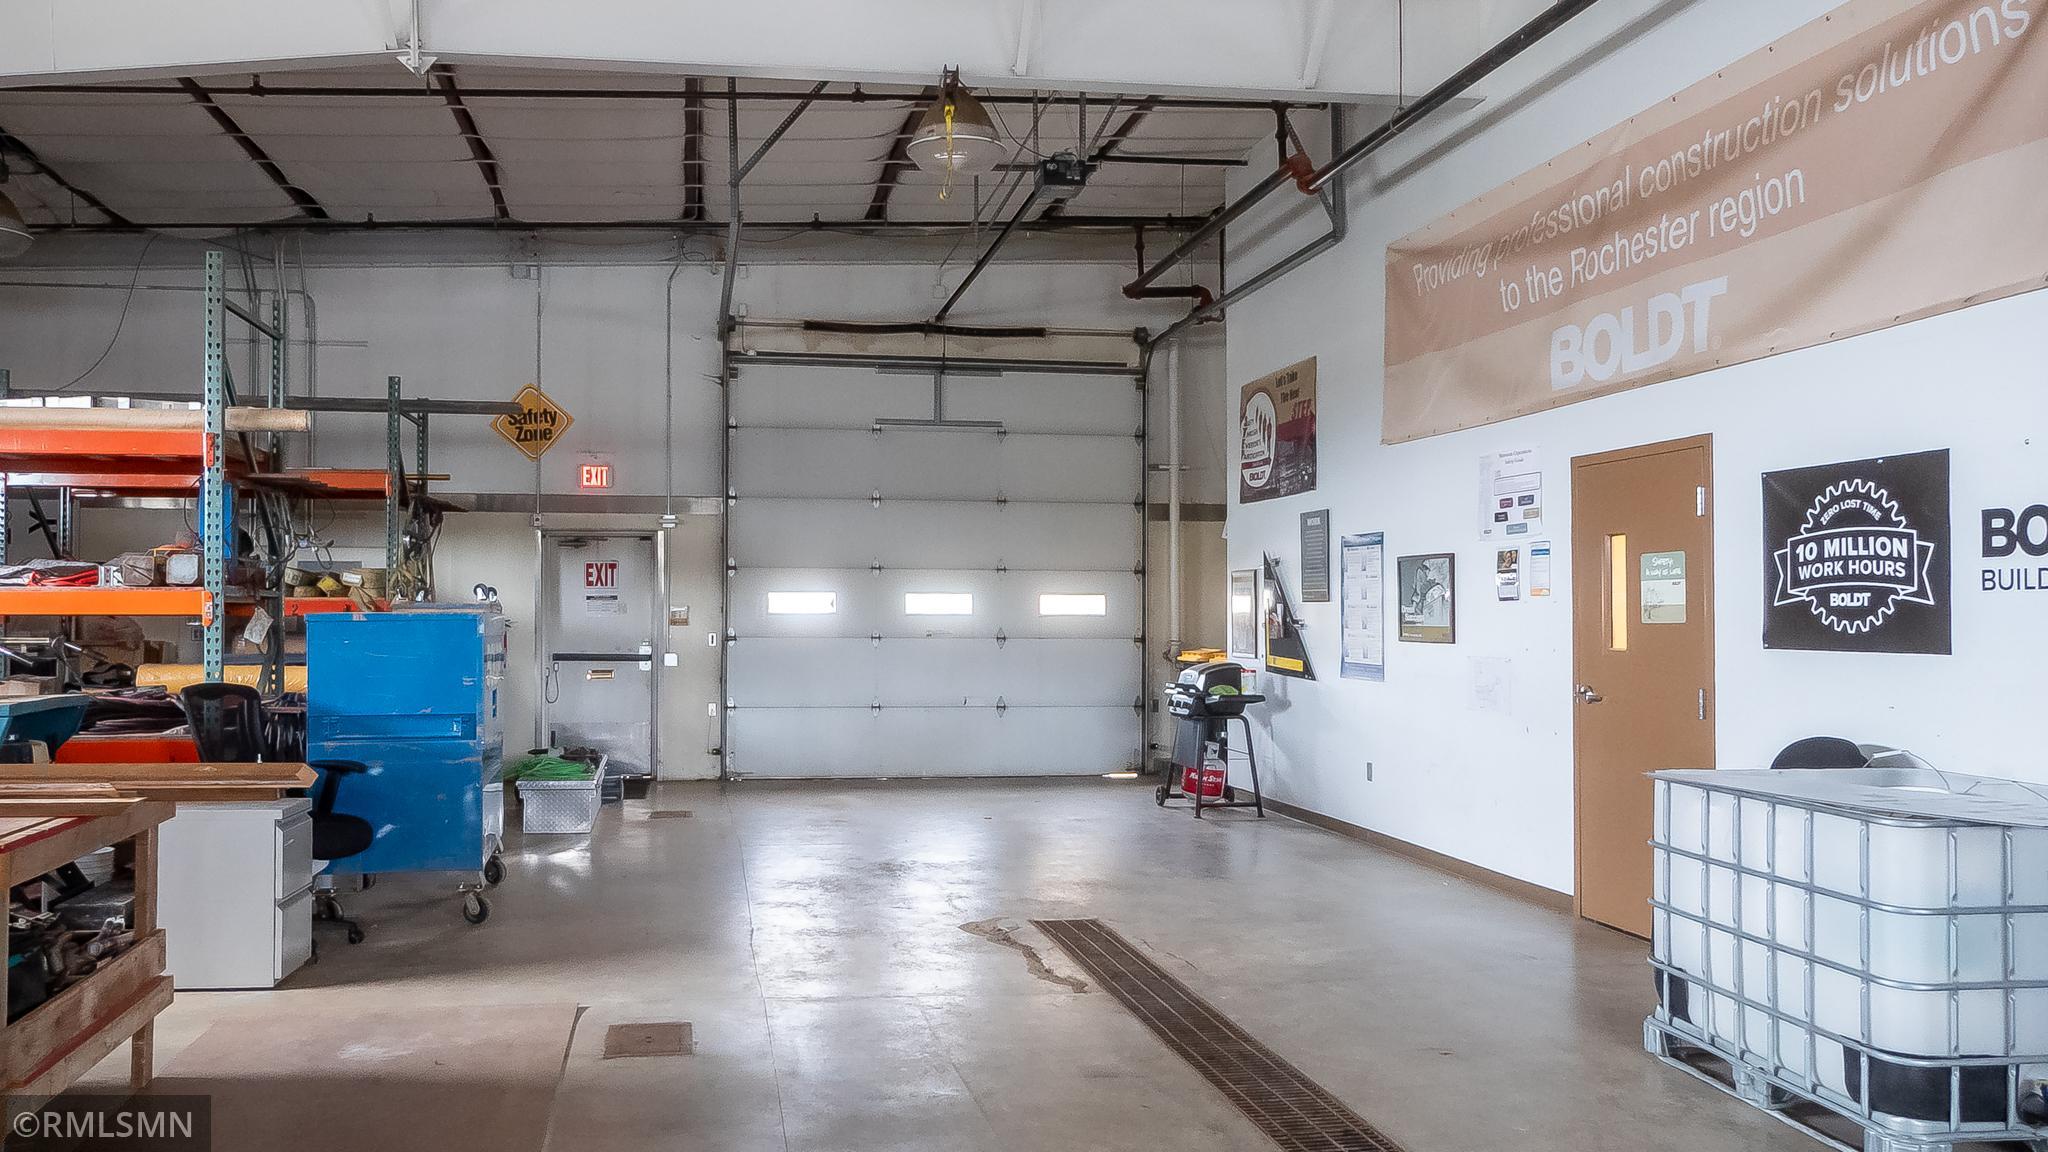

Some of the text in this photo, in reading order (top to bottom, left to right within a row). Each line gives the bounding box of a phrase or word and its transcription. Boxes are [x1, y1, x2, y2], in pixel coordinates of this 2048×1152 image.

[1413, 0, 2031, 296] Providing professional construction solutions
[1500, 168, 1805, 312] to the Rochester region
[1551, 275, 1729, 391] BOLDT
[508, 407, 557, 427] Safety
[514, 426, 553, 442] Zone
[582, 466, 609, 486] EXIT
[1820, 499, 1882, 525] ZERO LOST TIME
[1796, 536, 1908, 563] 10 MILLION
[585, 562, 618, 588] EXIT
[1798, 559, 1906, 580] WORK HOURS
[1829, 592, 1872, 607] BOLDT
